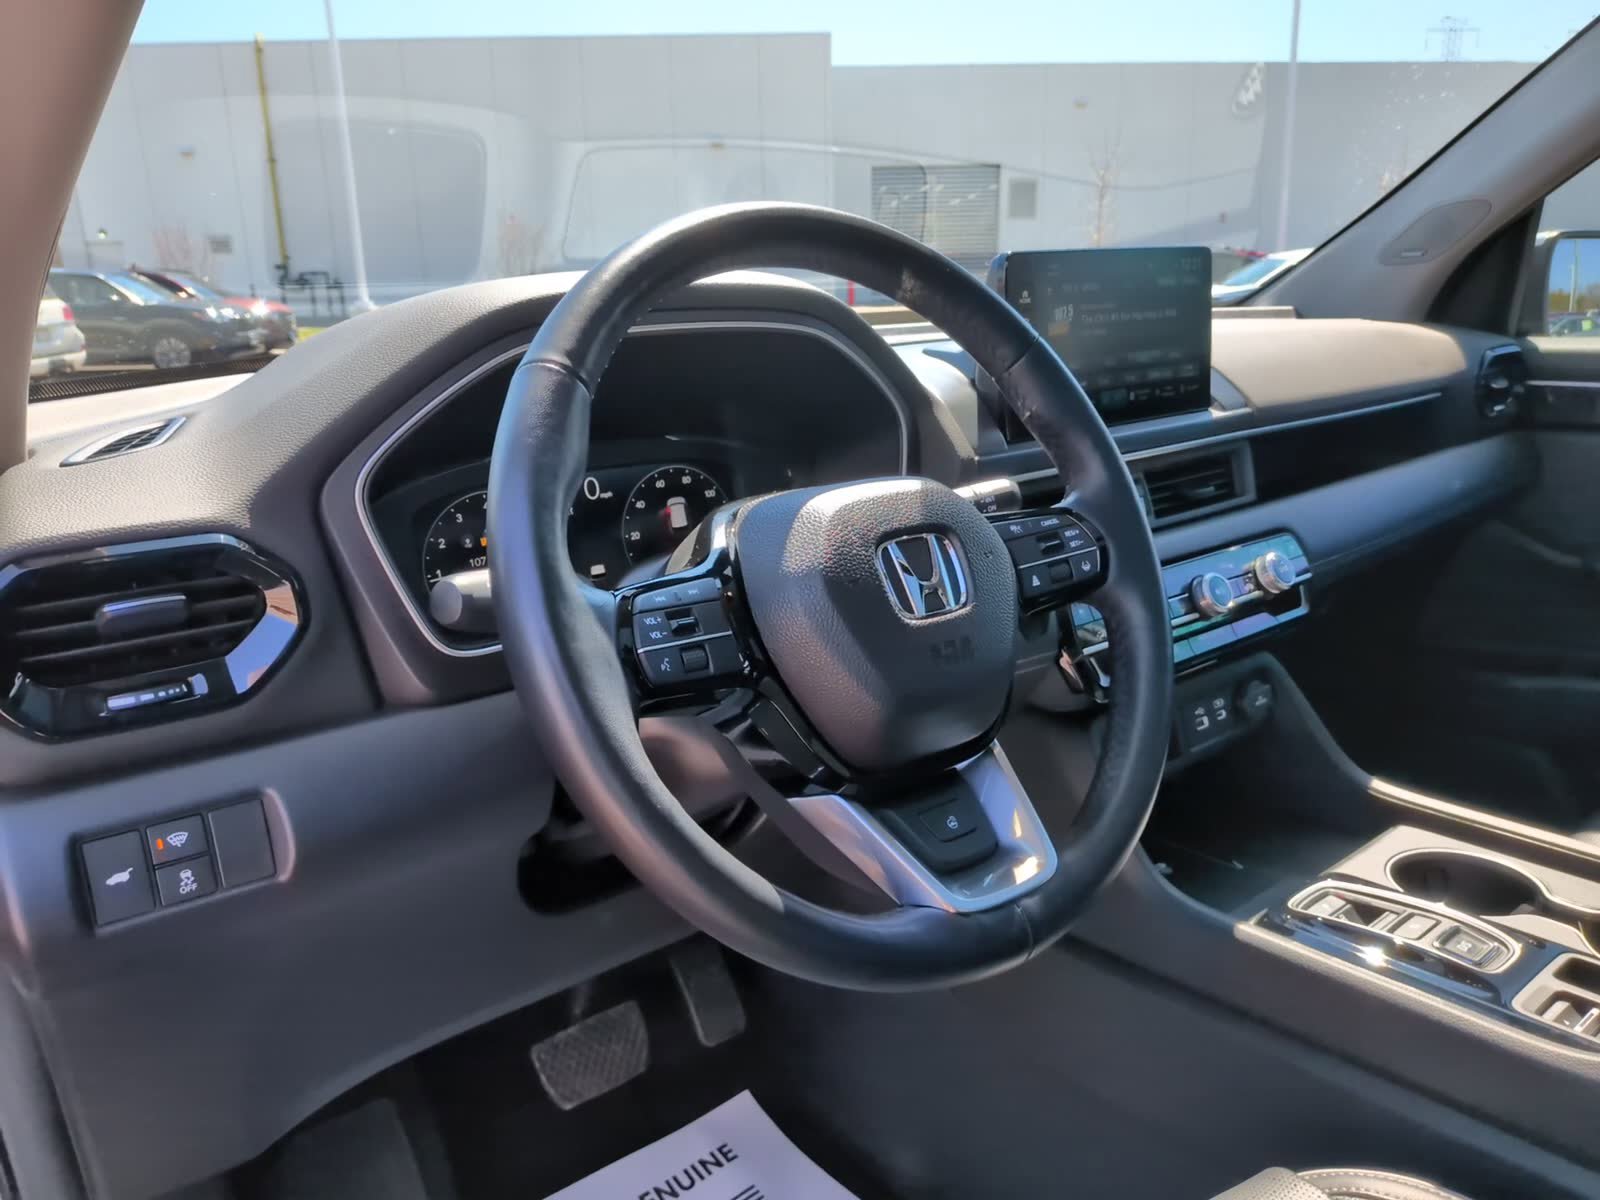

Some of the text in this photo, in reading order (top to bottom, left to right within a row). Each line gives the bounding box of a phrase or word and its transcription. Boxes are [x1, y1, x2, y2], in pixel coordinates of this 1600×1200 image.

[655, 479, 666, 488] 60
[681, 475, 692, 485] 80
[583, 476, 600, 500] 0
[704, 489, 716, 498] 100
[635, 499, 646, 509] 40
[455, 513, 463, 523] 3
[630, 531, 641, 541] 20
[438, 538, 446, 549] 2
[179, 883, 197, 894] OFF
